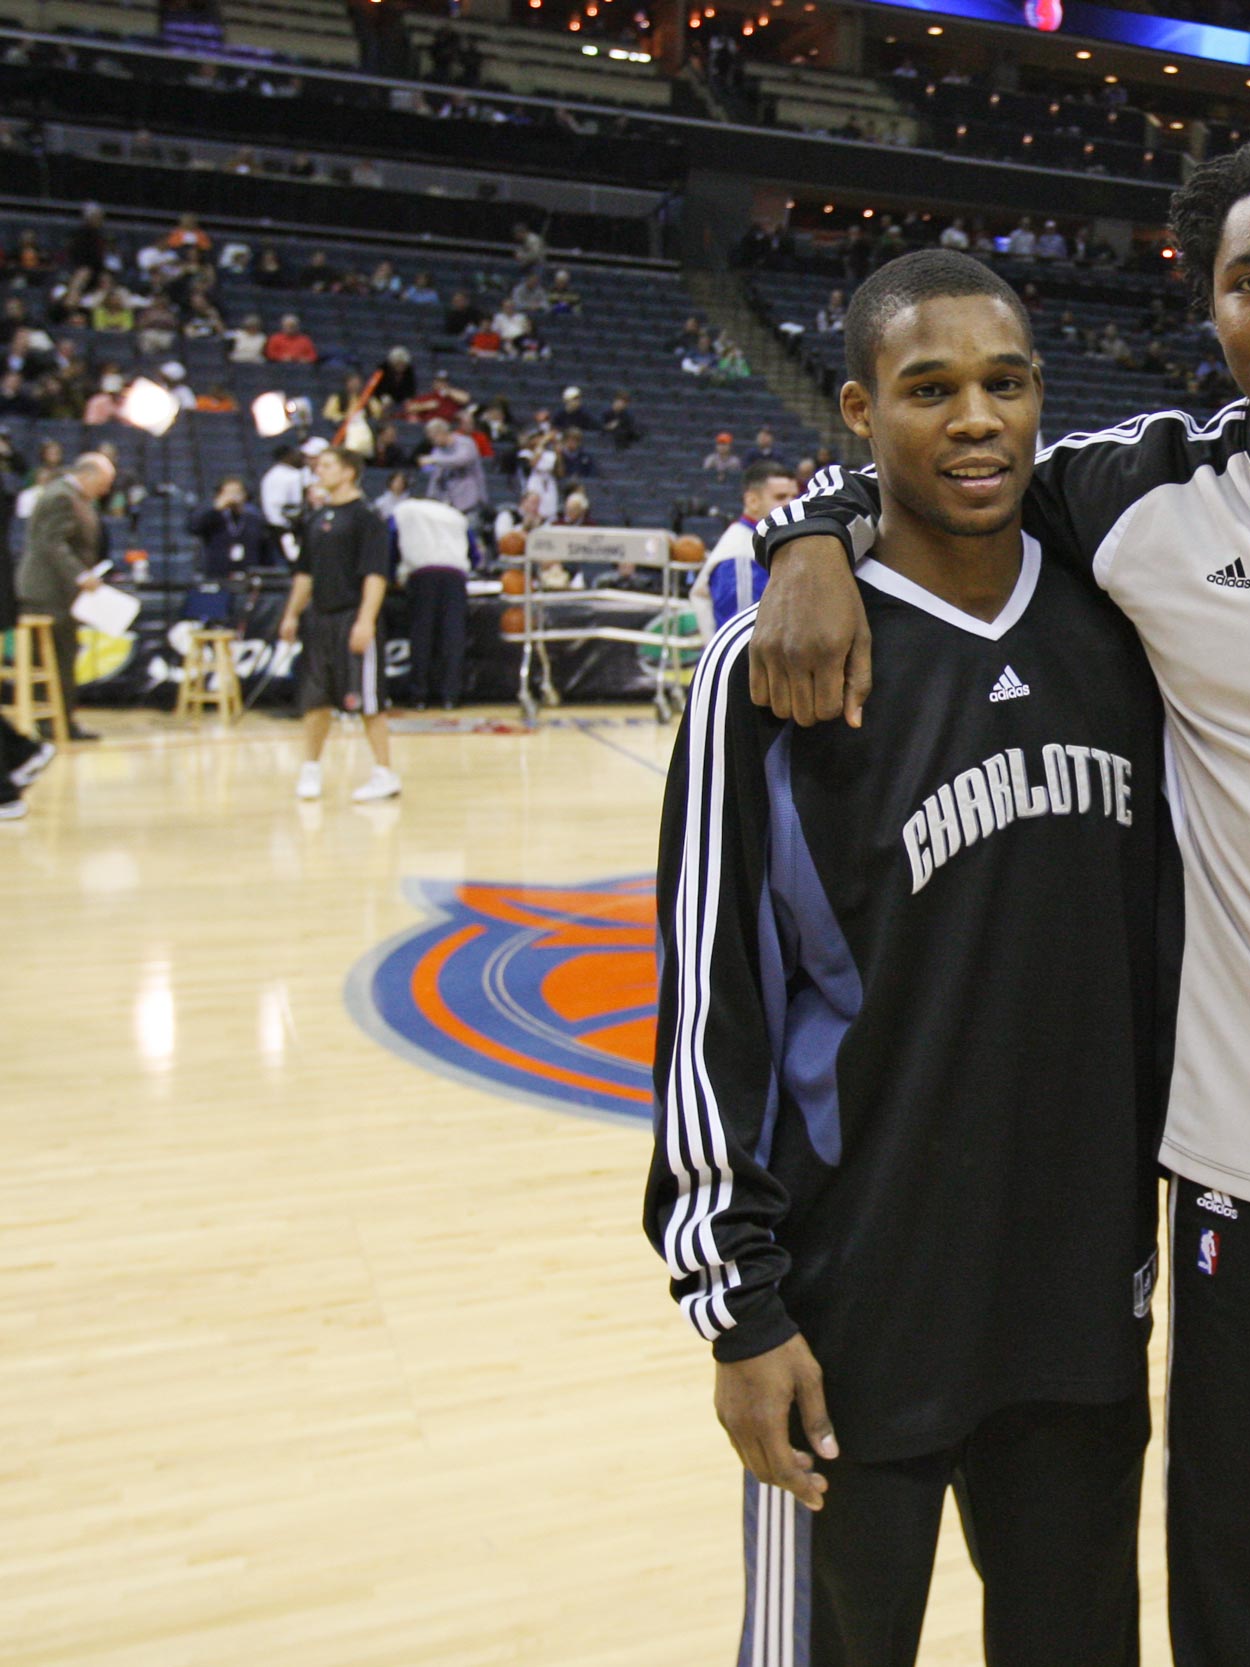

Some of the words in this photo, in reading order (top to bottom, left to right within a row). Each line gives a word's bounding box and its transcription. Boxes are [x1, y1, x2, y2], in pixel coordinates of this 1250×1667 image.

[989, 684, 1030, 703] adidas
[902, 743, 1133, 895] CHARLOTTE
[1196, 1197, 1239, 1220] adidas
